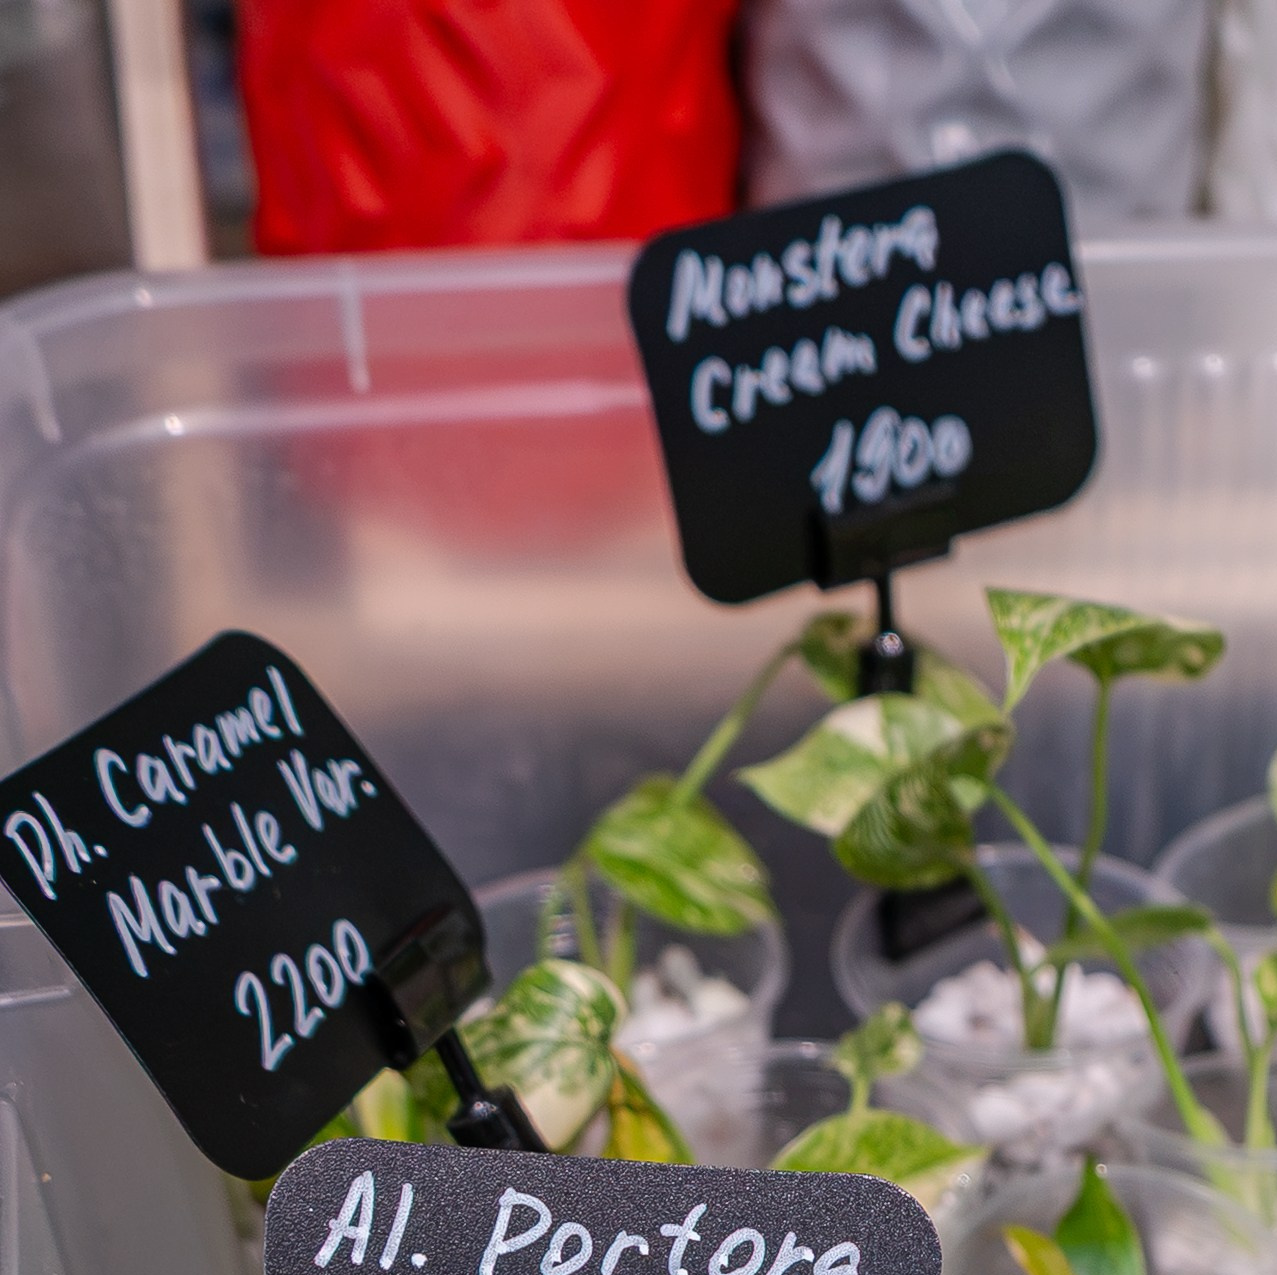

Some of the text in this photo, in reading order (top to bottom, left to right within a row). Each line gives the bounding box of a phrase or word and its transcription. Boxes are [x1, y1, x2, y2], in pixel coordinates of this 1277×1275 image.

[667, 206, 938, 341] Monstera
[691, 263, 1083, 432] Cream Cheese
[811, 407, 972, 513] 1900
[94, 665, 304, 828] Caramel
[107, 802, 298, 978] Marble
[235, 918, 373, 1071] 2200
[314, 1170, 428, 1270] Al.
